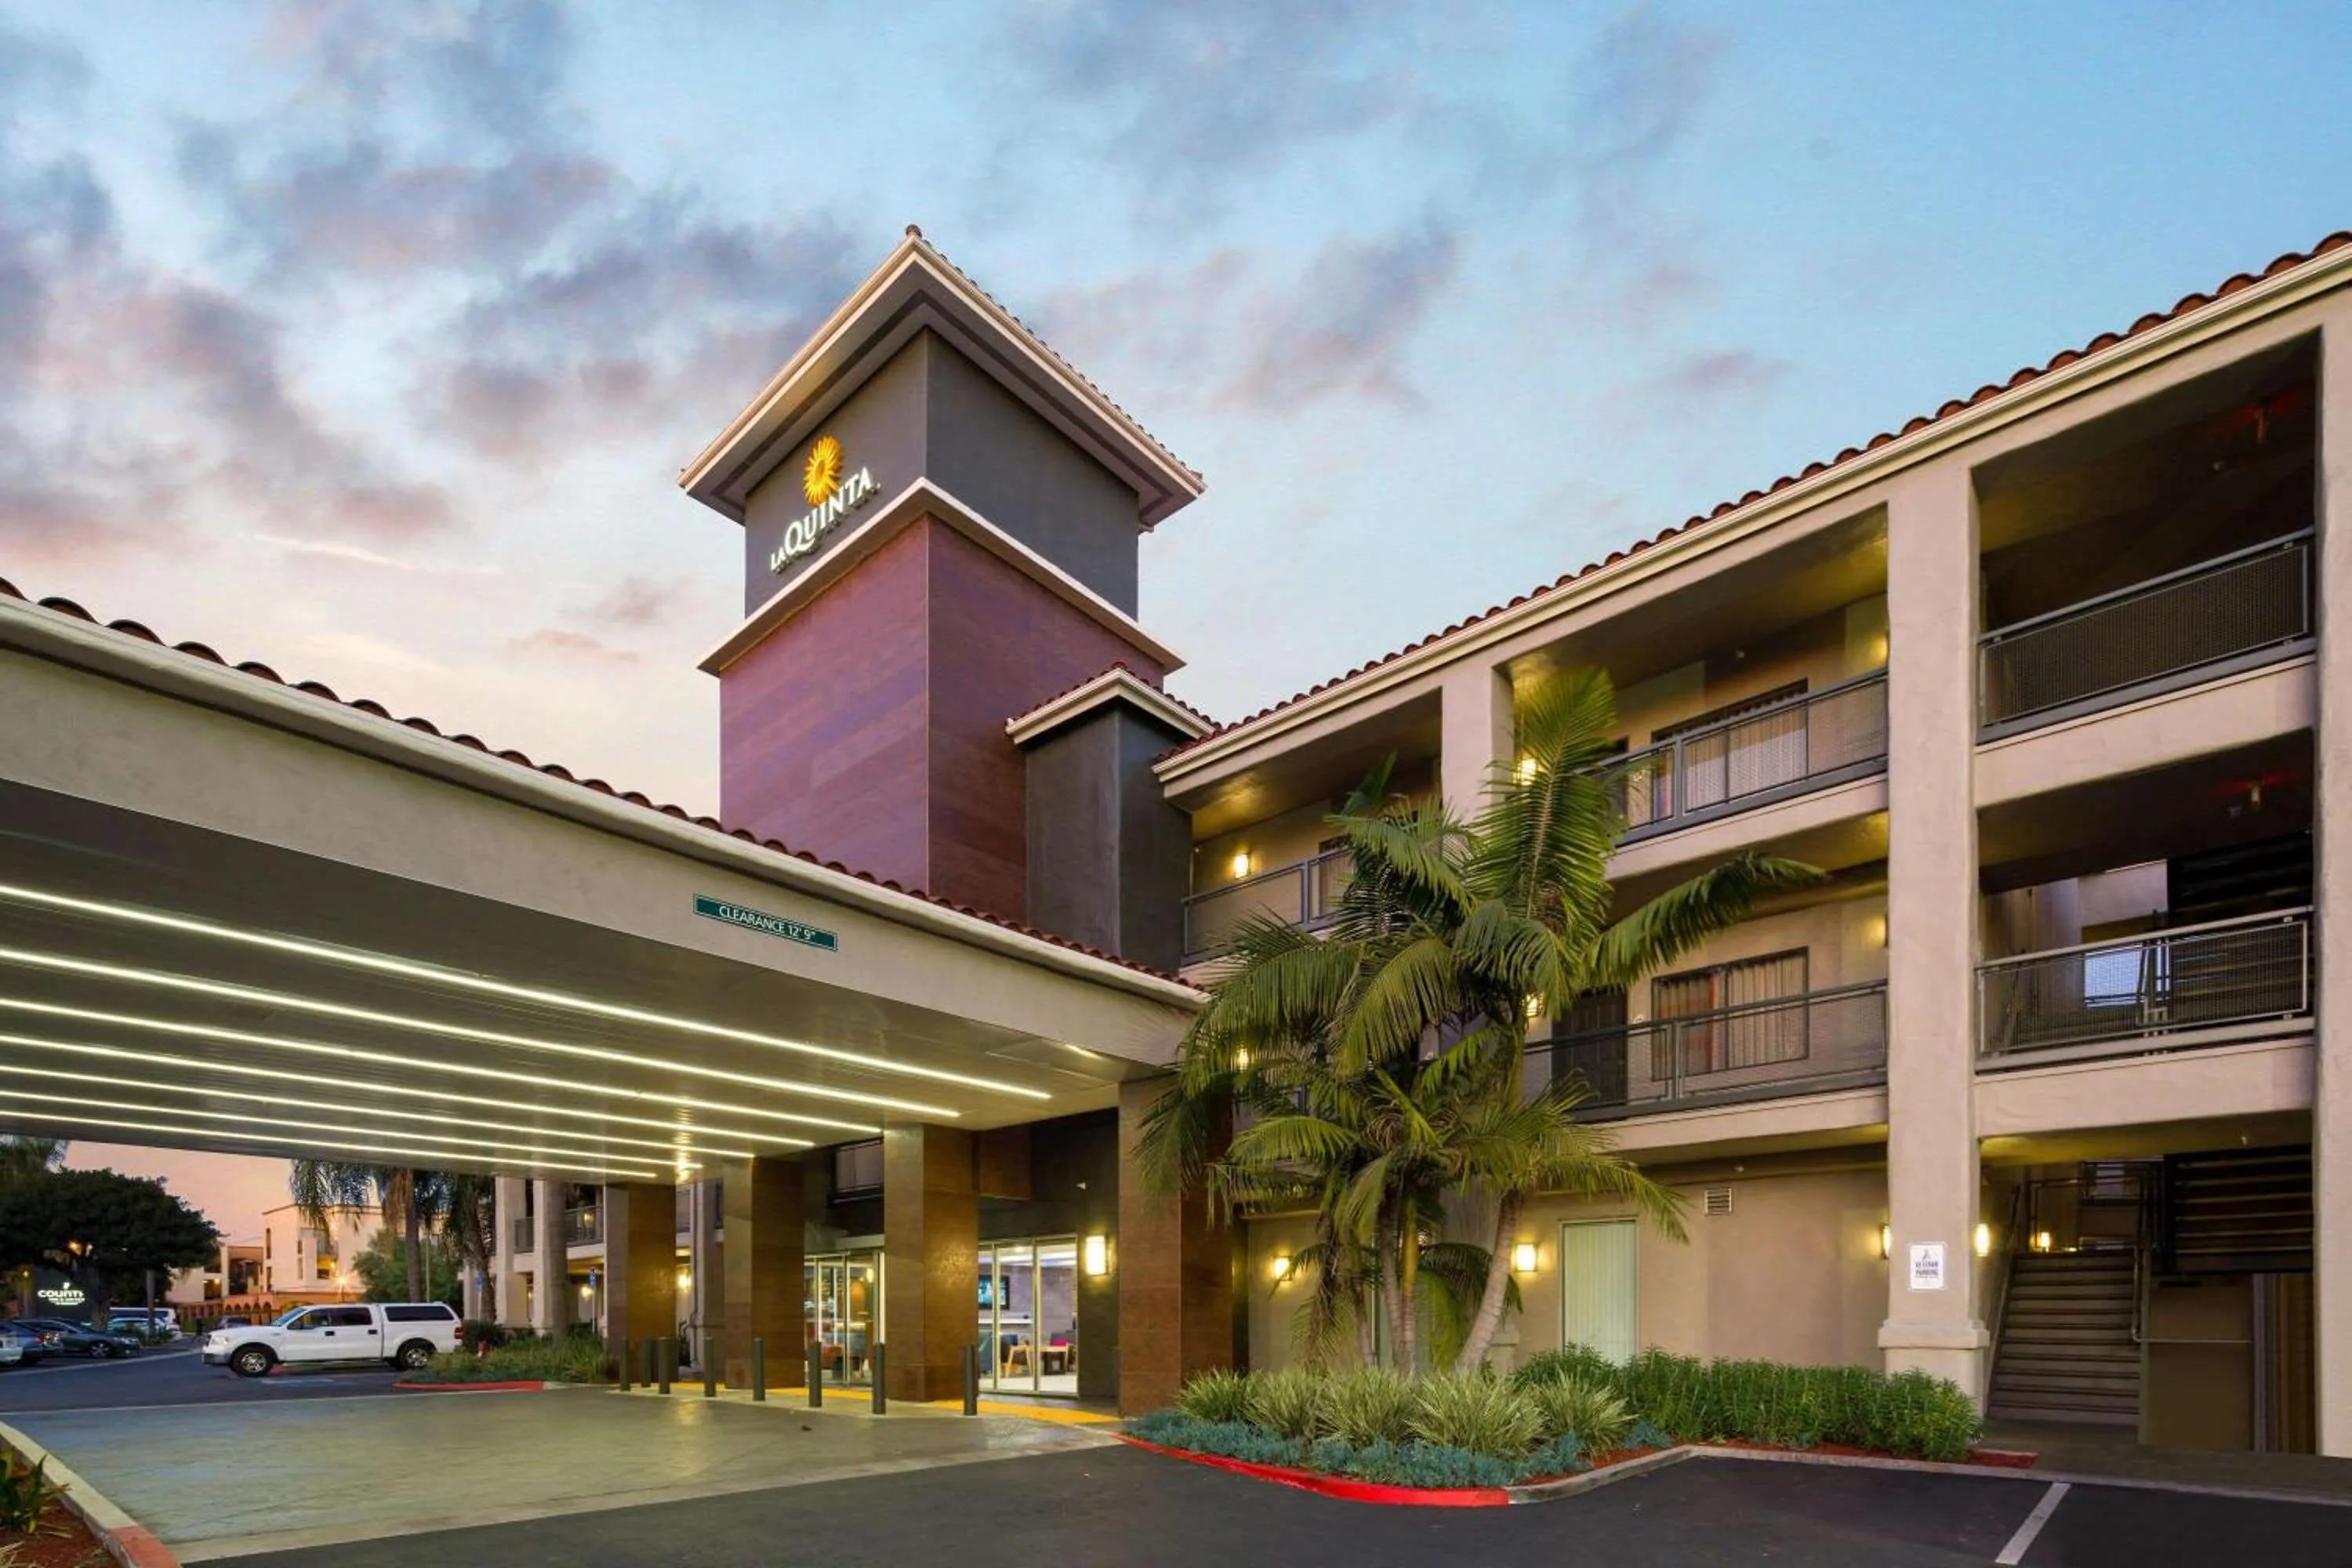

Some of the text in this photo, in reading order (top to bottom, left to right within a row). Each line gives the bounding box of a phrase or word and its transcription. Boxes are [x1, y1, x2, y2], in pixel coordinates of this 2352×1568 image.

[771, 466, 872, 571] LA QUINTA
[719, 906, 786, 933] CLEARANCE
[788, 924, 802, 937] 12'
